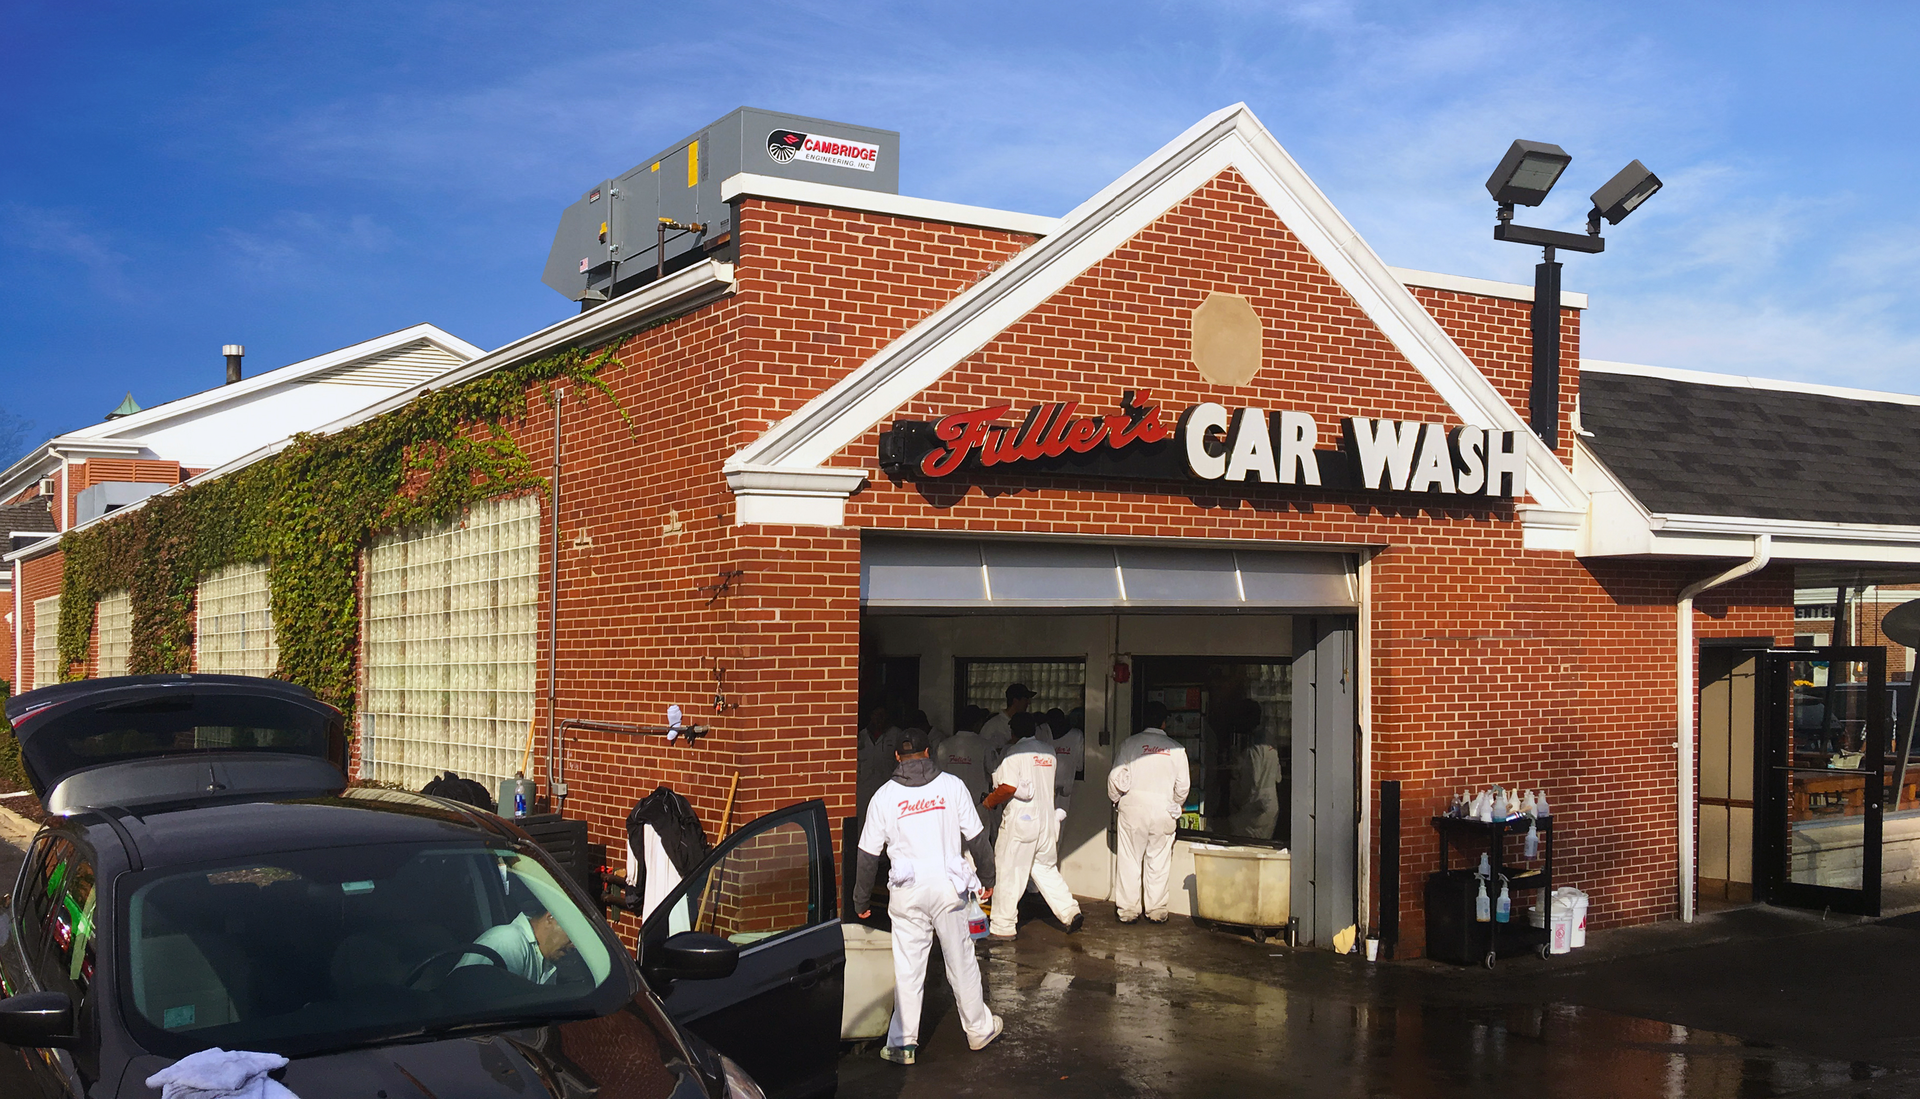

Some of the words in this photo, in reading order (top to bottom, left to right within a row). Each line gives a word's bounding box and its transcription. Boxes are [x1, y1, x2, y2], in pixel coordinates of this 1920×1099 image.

[804, 138, 877, 162] CAMBRIDGE
[921, 388, 1168, 478] Fuller's
[1185, 402, 1322, 486] CAR
[1352, 416, 1528, 497] WASH
[1142, 745, 1171, 754] Fuller's
[898, 795, 946, 817] Fuller's
